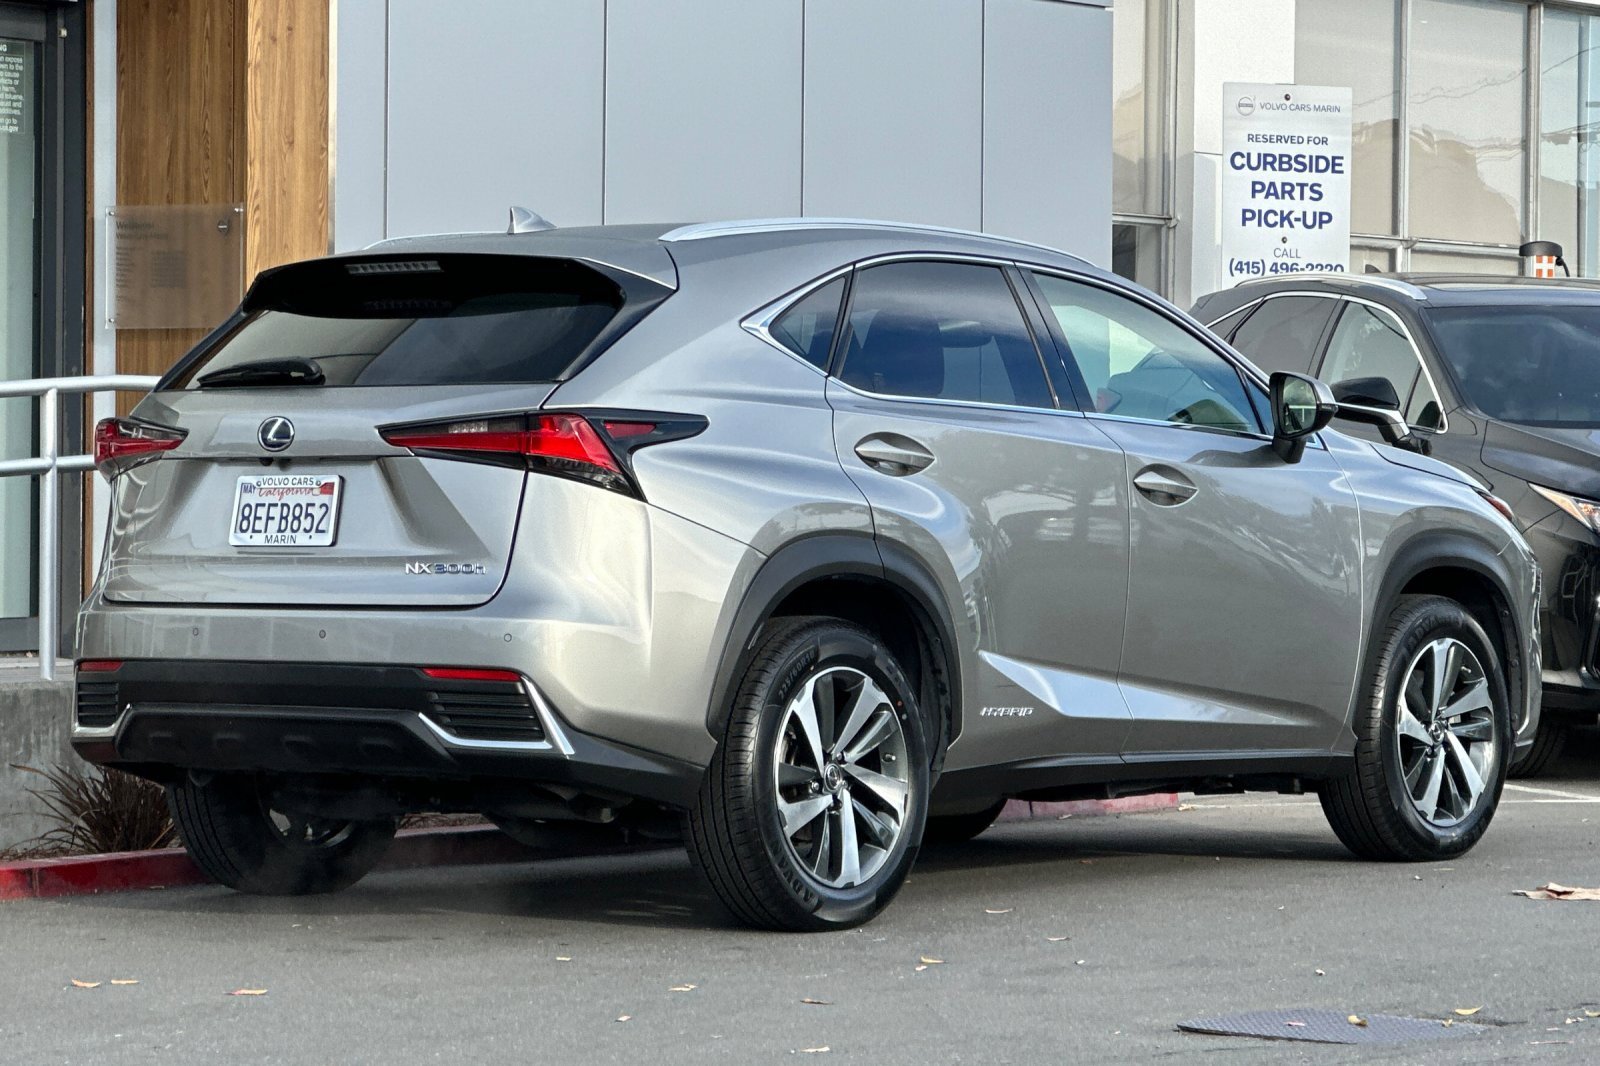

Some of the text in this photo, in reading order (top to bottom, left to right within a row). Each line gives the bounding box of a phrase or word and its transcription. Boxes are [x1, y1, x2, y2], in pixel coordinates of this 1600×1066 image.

[1259, 102, 1287, 111] VOLVO
[1289, 103, 1312, 112] CARS
[1313, 104, 1341, 113] MARIN
[1247, 133, 1329, 146] RESERVED FOR
[1229, 151, 1345, 175] CURBSIDE
[1250, 180, 1324, 202] PARTS
[1241, 208, 1333, 230] PICK-UP
[1273, 247, 1301, 259] CALL
[1229, 257, 1266, 277] (415)
[262, 477, 314, 486] VOLVO CARS
[242, 483, 256, 494] MAY
[239, 502, 329, 534] 8EFB852
[264, 534, 297, 544] MARIN
[980, 706, 1035, 717] HYBRID
